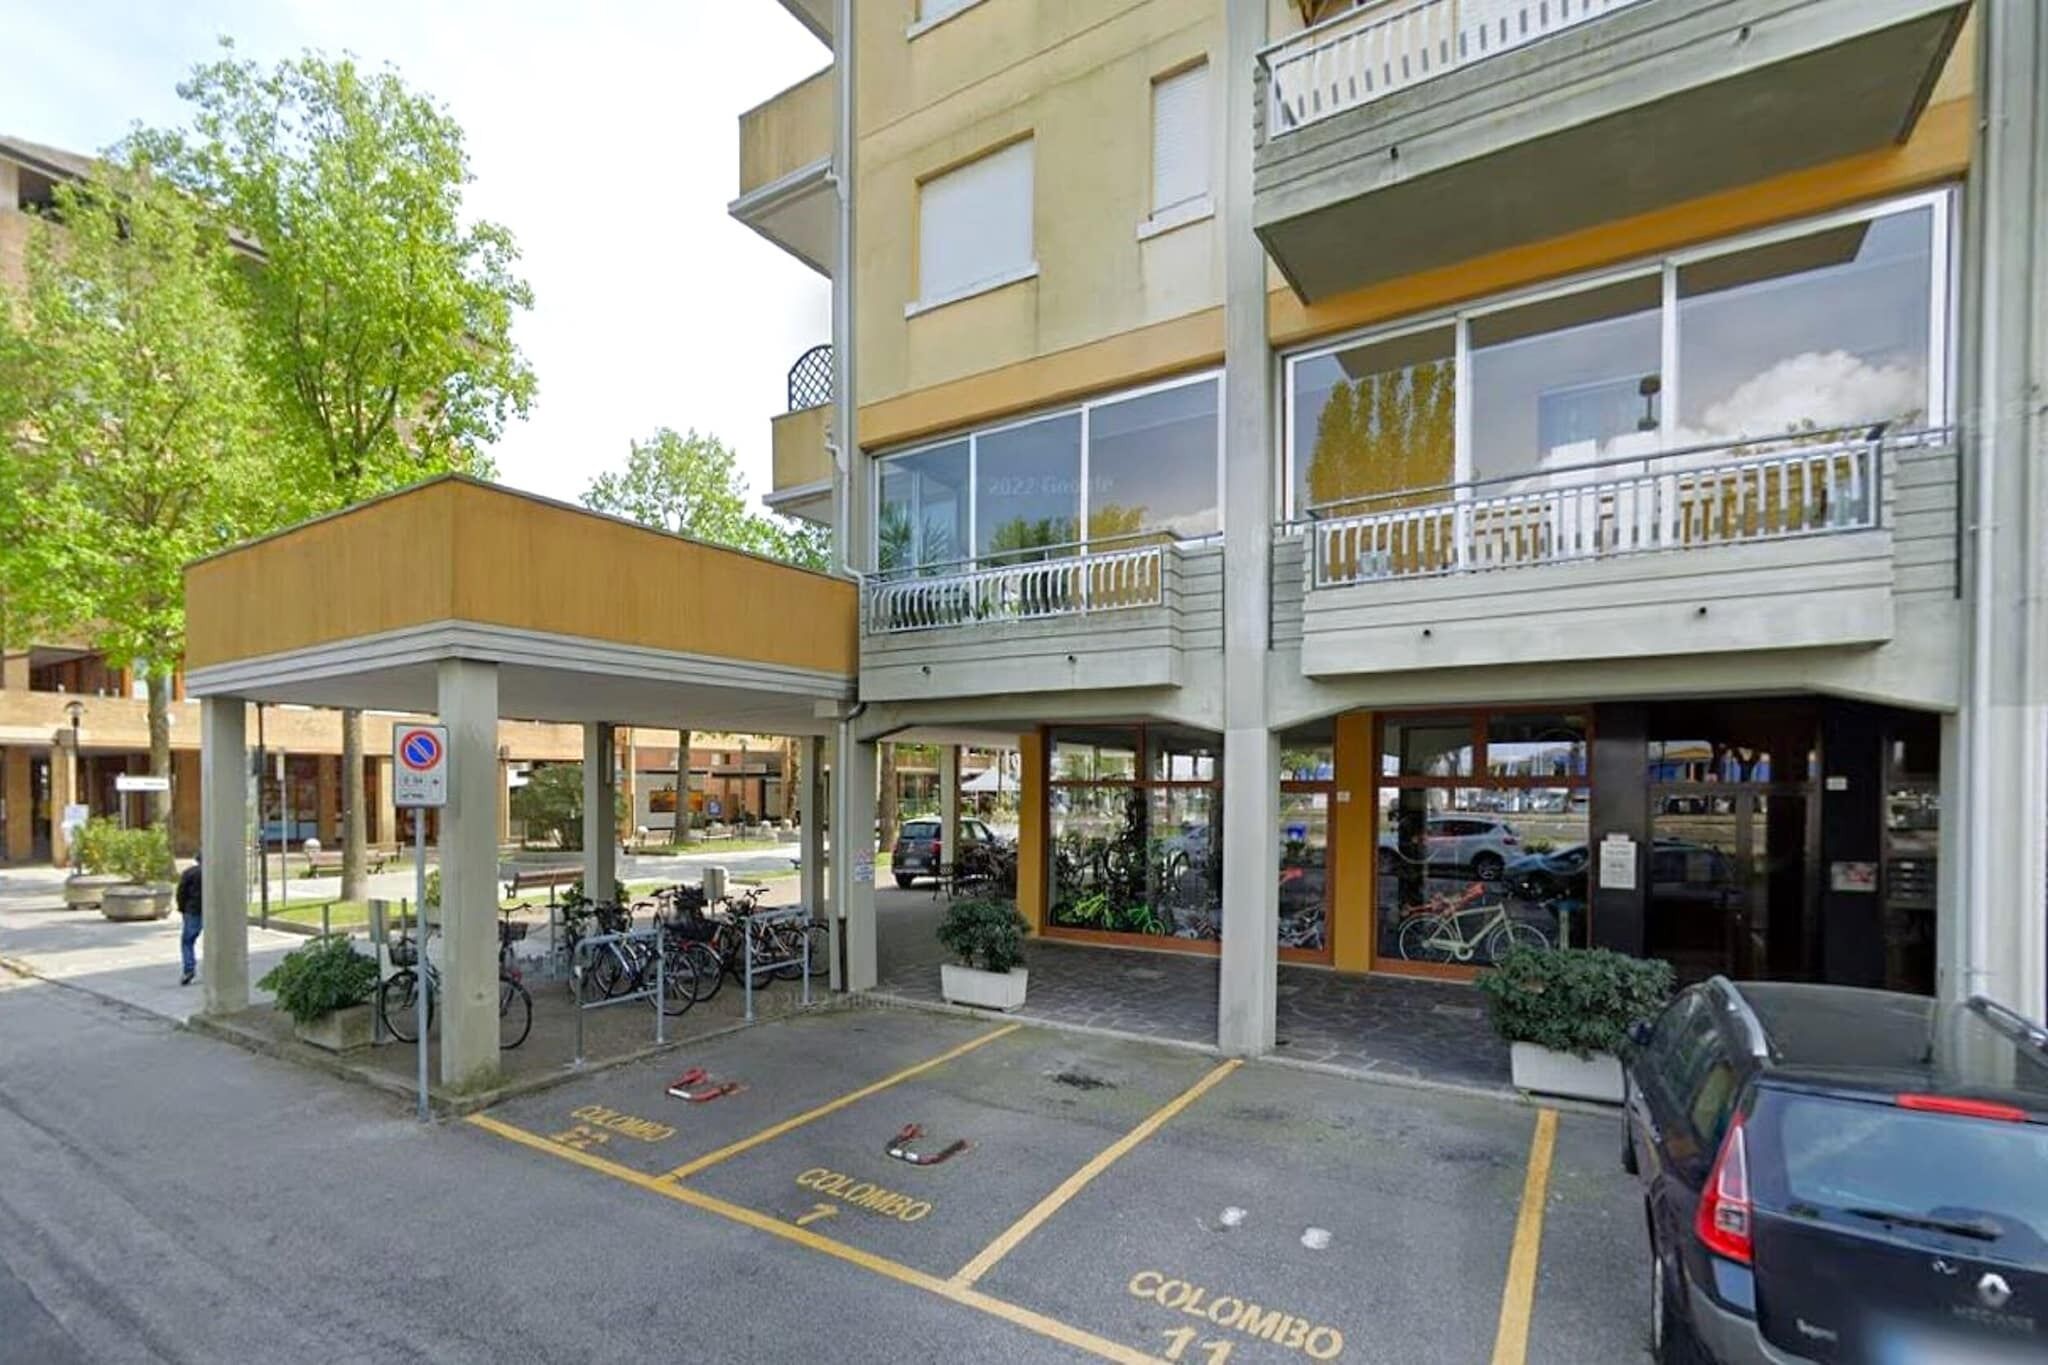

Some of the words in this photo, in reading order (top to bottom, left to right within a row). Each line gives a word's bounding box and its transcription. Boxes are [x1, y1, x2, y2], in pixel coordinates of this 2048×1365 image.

[570, 1105, 678, 1142] COLOMBO
[796, 1167, 932, 1222] COLOMBO
[1129, 1270, 1344, 1360] COLOMBO
[1162, 1325, 1235, 1365] 11
